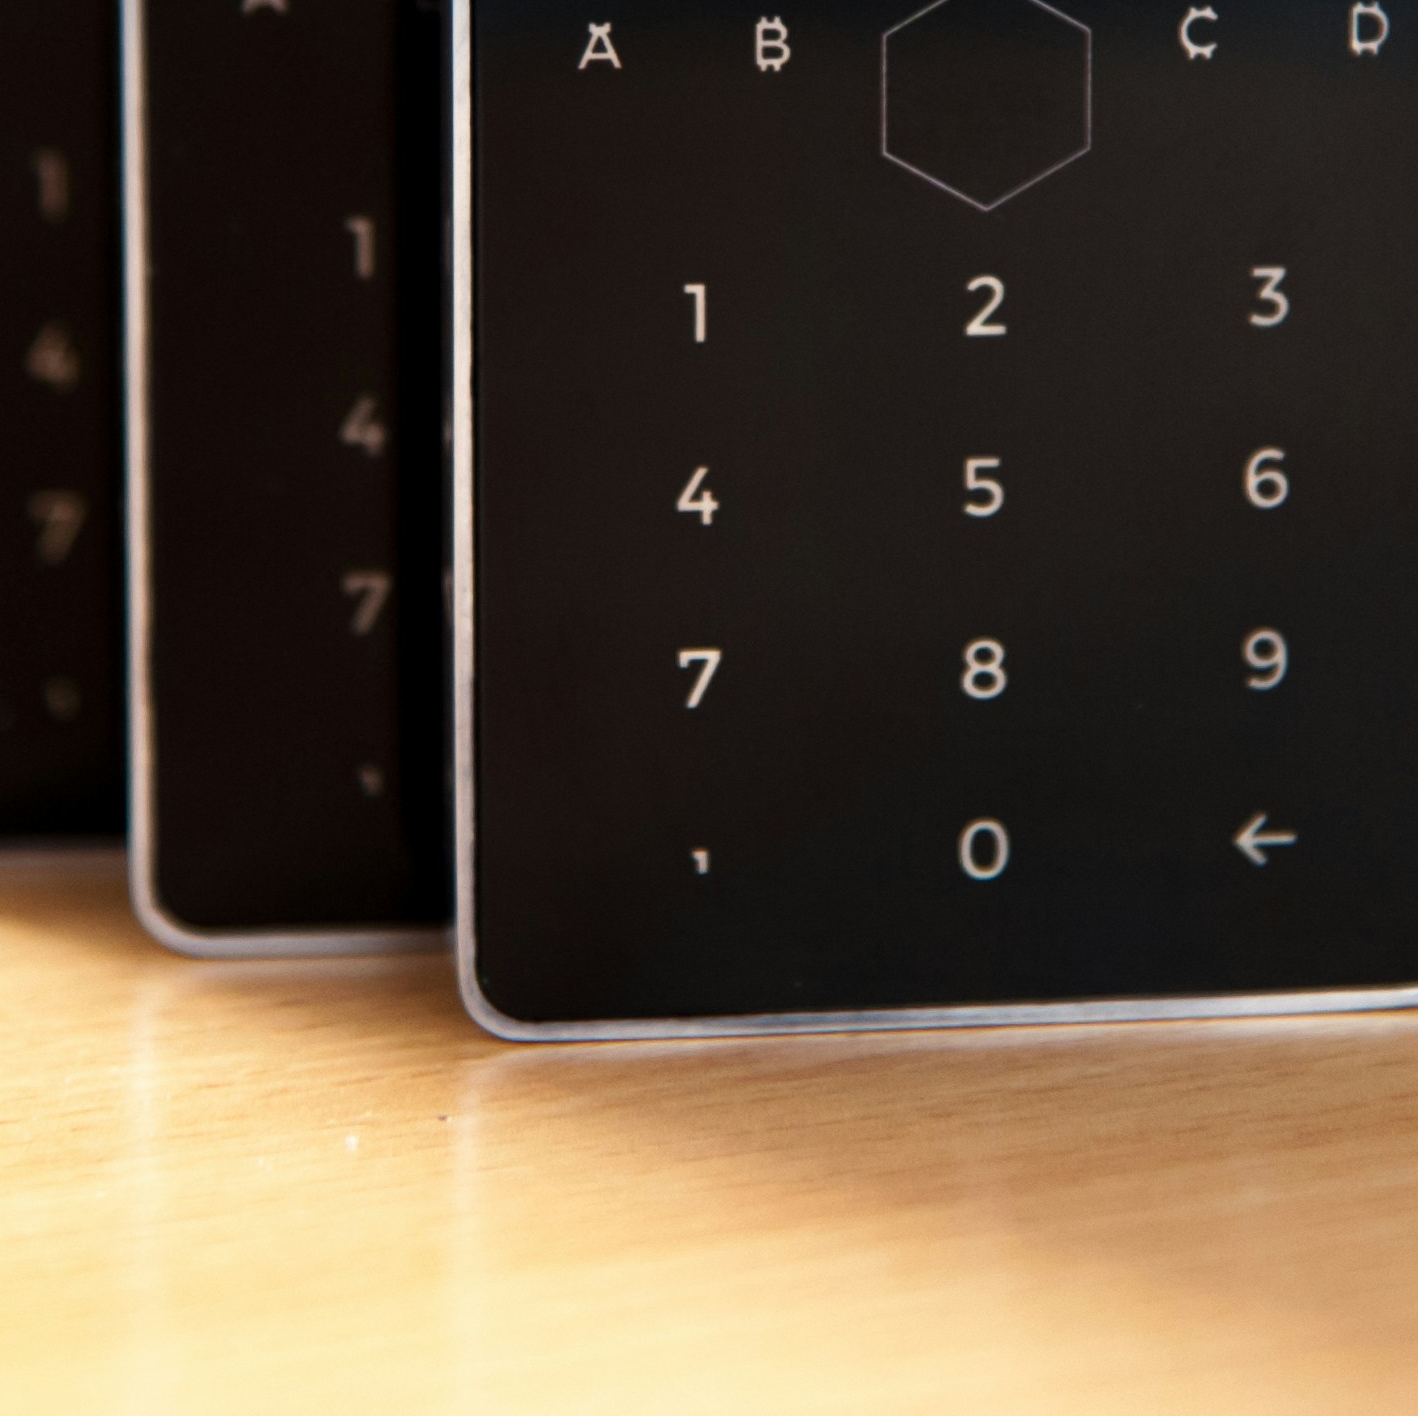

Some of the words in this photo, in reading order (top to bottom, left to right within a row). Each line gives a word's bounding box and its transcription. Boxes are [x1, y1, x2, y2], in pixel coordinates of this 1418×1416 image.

[343, 213, 377, 281] 1
[681, 281, 708, 345] 1
[963, 273, 1009, 338] 2
[1247, 264, 1291, 329] 3
[337, 394, 388, 458] 4
[674, 464, 721, 527] 4
[962, 455, 1006, 519] 5
[1242, 445, 1291, 511] 6
[339, 568, 393, 637] 7
[676, 646, 724, 710] 7
[959, 636, 1009, 701] 8
[1240, 626, 1290, 692] 9
[957, 816, 1011, 882] 0
